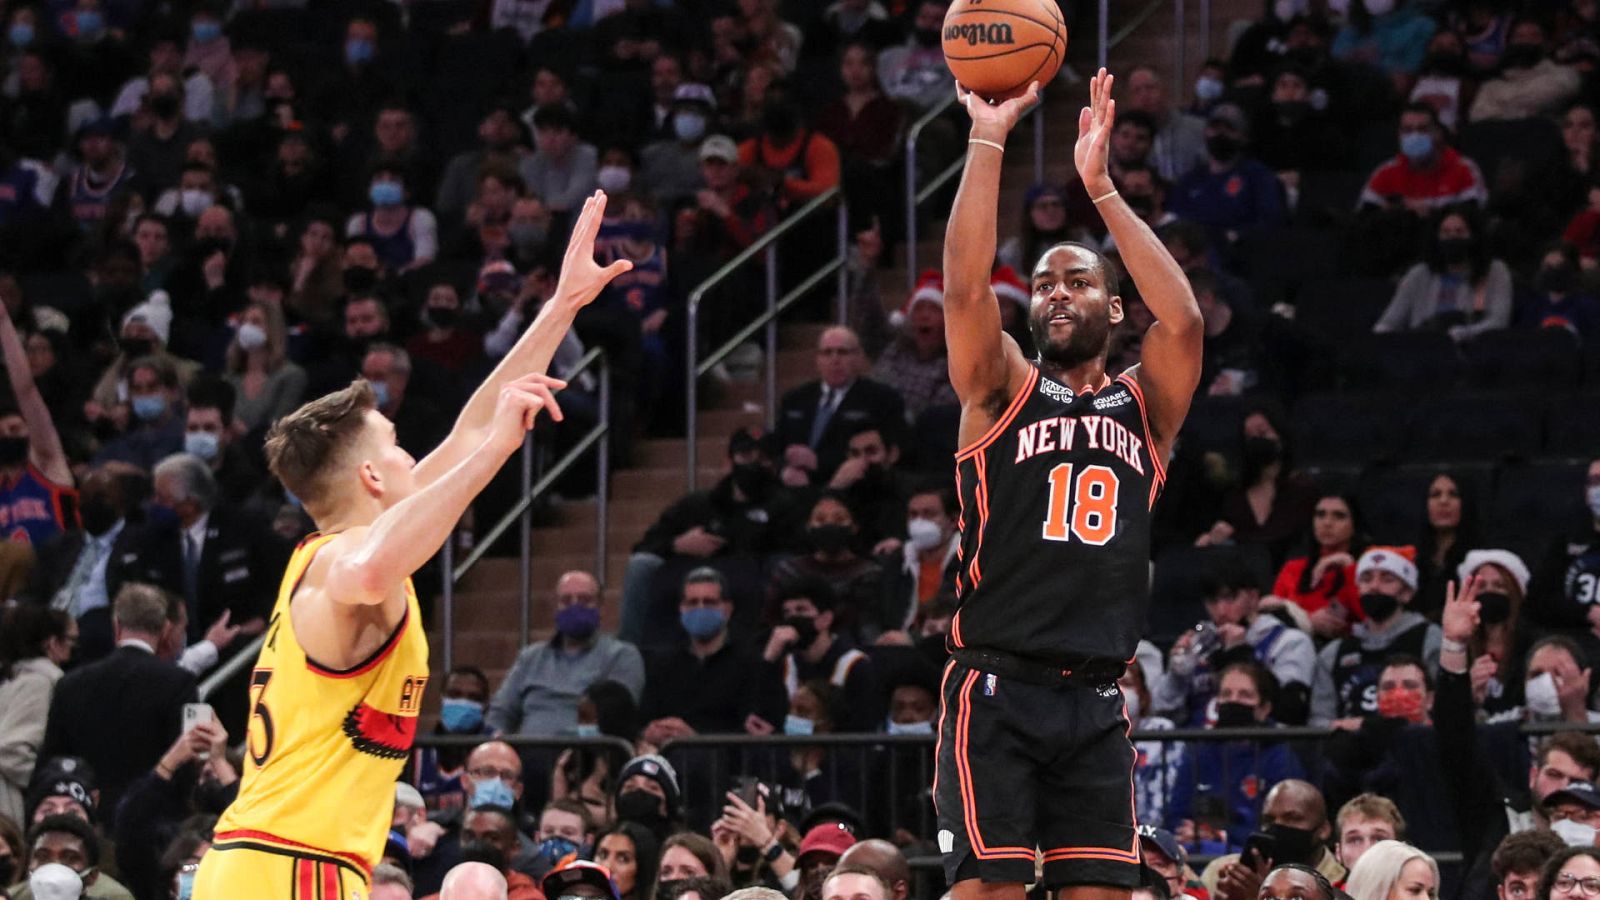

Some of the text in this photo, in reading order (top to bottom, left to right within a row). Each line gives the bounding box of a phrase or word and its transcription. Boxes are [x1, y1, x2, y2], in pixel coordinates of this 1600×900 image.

[944, 23, 1014, 46] Wilson
[1095, 398, 1125, 410] SPACE
[1015, 415, 1144, 476] NEW YORK
[1042, 462, 1120, 546] 18
